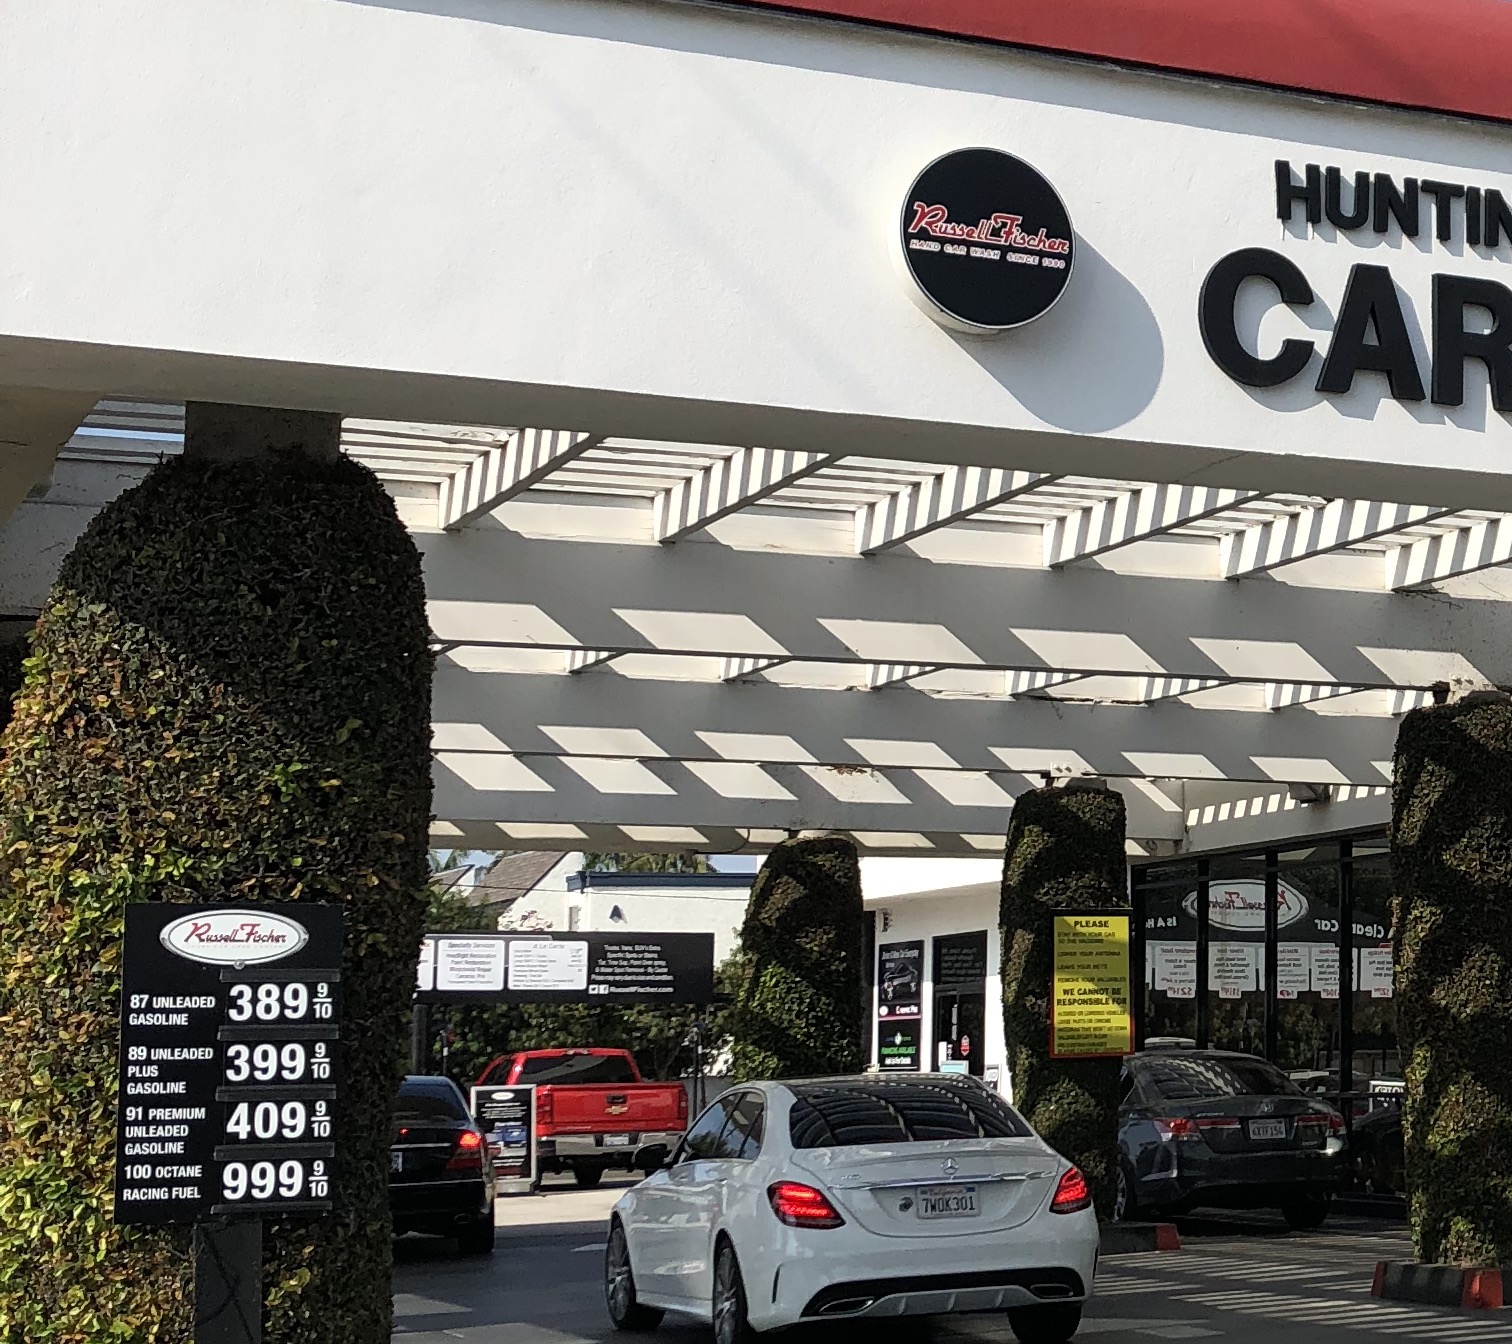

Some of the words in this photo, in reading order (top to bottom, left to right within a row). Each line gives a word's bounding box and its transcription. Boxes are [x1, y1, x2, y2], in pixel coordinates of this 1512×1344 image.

[908, 201, 1003, 244] Russell
[991, 213, 1069, 254] Fischer
[909, 239, 941, 252] HAND
[943, 244, 967, 256] CAR
[969, 246, 1001, 260] WASH
[1006, 251, 1039, 265] SINCE
[1074, 920, 1109, 928] PLEASE
[184, 922, 244, 943] Russell
[239, 922, 287, 943] Fischer
[316, 982, 329, 998] 9
[1062, 988, 1075, 996] WE
[1077, 988, 1109, 996] CANNOT
[130, 994, 149, 1009] 87
[152, 996, 216, 1009] UNLEADED
[228, 982, 309, 1022] 389
[1056, 998, 1110, 1006] RESPONSIBLE
[313, 1002, 333, 1019] 10
[129, 1012, 189, 1026] GASOLINE
[127, 1046, 147, 1061] 89
[150, 1047, 214, 1060] UNLEADED
[314, 1042, 327, 1058] 9
[225, 1043, 306, 1082] 399
[127, 1065, 159, 1078] PLUS
[311, 1063, 331, 1080] 10
[127, 1081, 187, 1095] GASOLINE
[126, 1106, 144, 1121] 91
[148, 1107, 206, 1121] PREMIUM
[314, 1100, 327, 1116] 9
[226, 1101, 307, 1140] 409
[125, 1124, 189, 1138] UNLEADED
[311, 1121, 331, 1138] 10
[124, 1142, 185, 1155] GASOLINE
[124, 1164, 152, 1179] 100
[155, 1165, 202, 1178] OCTANE
[312, 1160, 325, 1176] 9
[222, 1160, 304, 1200] 999
[123, 1187, 169, 1201] RACING
[171, 1186, 202, 1200] FUEL
[308, 1181, 329, 1197] 10
